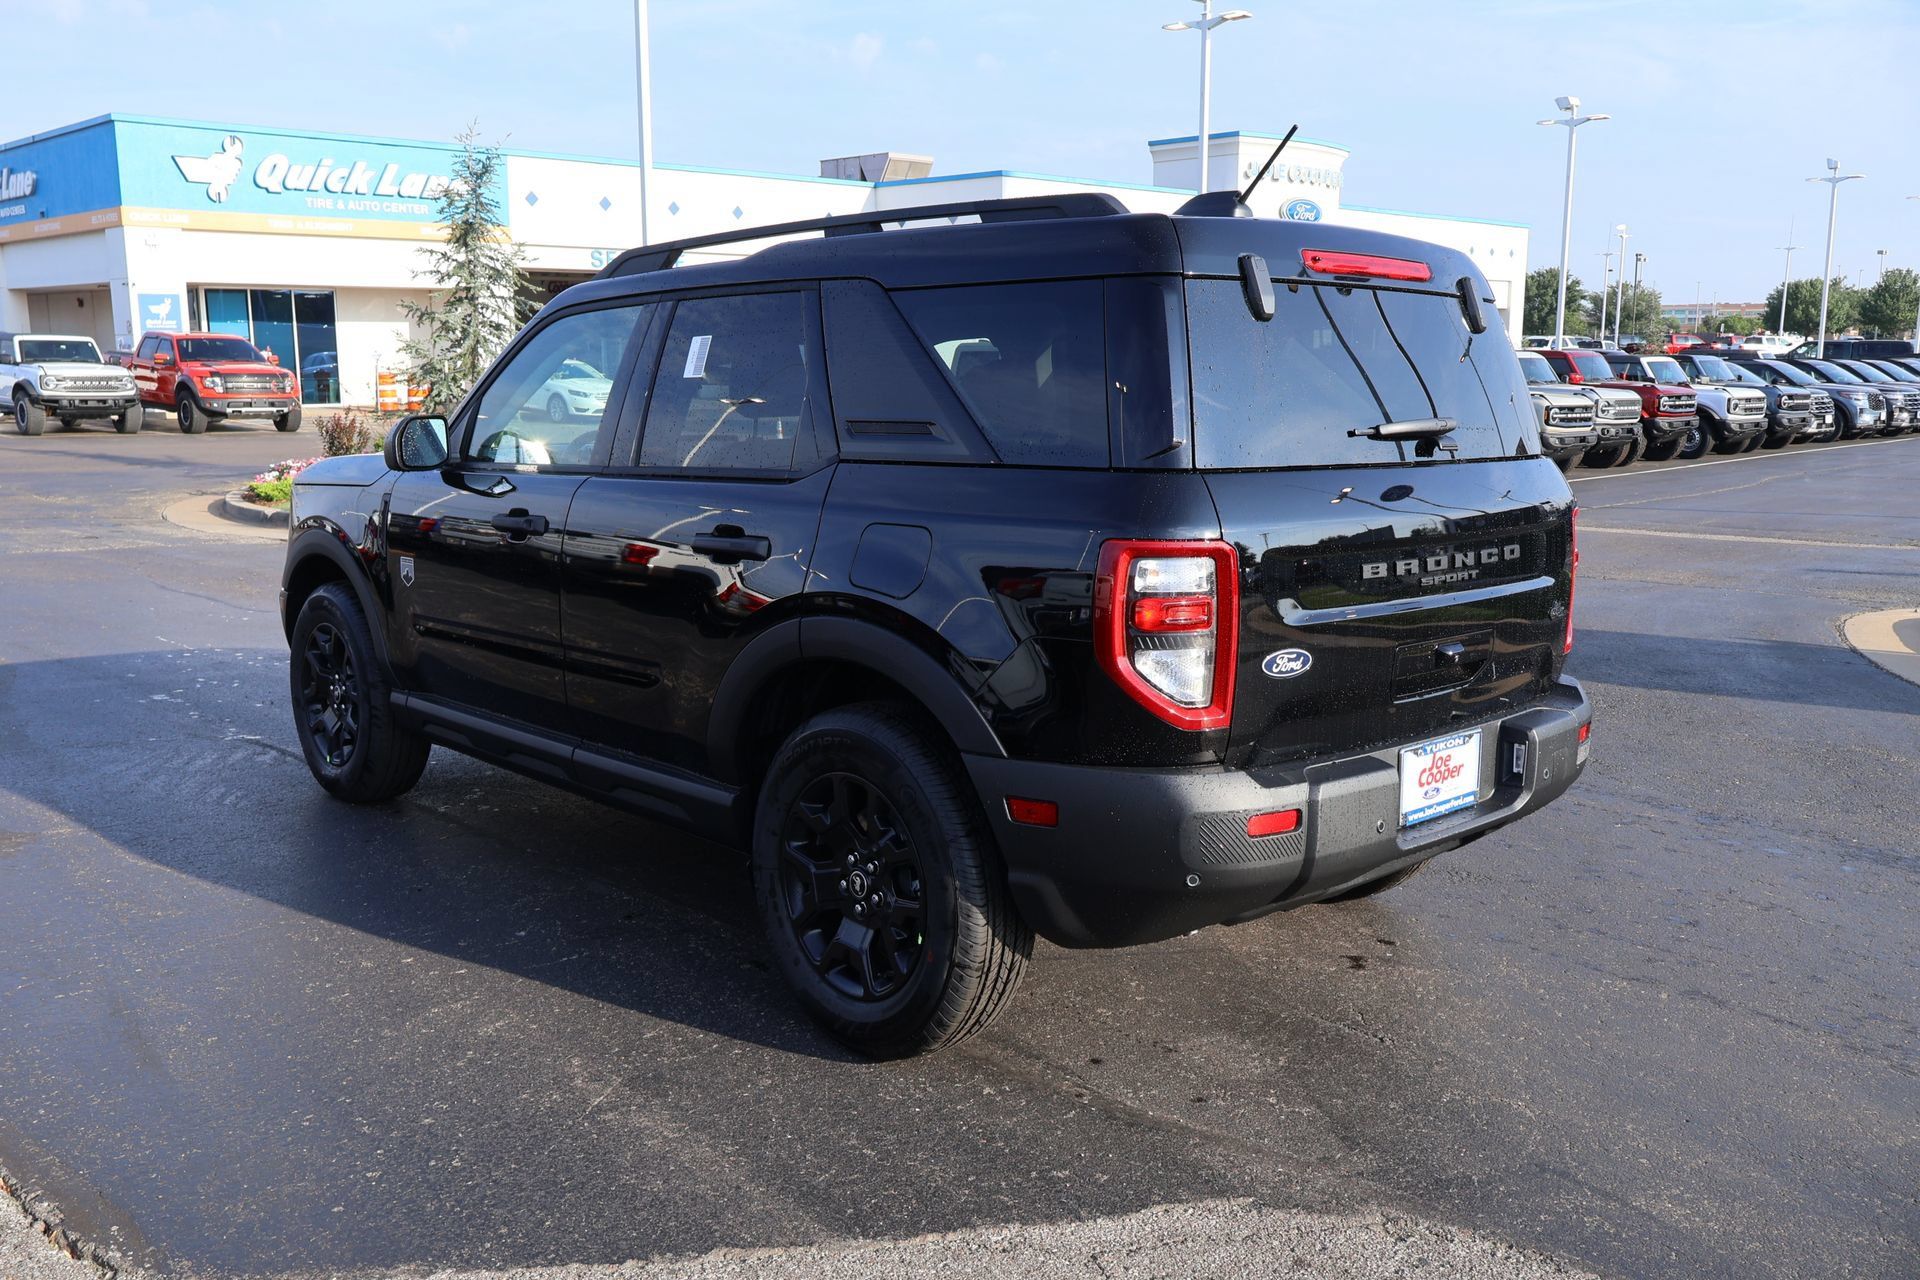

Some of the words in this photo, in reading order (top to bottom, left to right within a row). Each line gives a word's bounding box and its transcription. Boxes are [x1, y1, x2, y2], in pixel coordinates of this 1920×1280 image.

[1, 167, 35, 200] Lane
[253, 153, 376, 194] Quick
[305, 197, 334, 209] TIRE
[336, 198, 345, 210] &
[348, 199, 382, 213] AUTO
[383, 202, 428, 215] CENTER
[1289, 202, 1319, 222] Ford
[1361, 544, 1521, 580] BRONCO
[1420, 568, 1480, 587] SPORT
[1271, 652, 1305, 673] Ford
[1424, 736, 1464, 754] YUKON
[1427, 751, 1453, 773] Joe
[1417, 763, 1465, 788] Cooper
